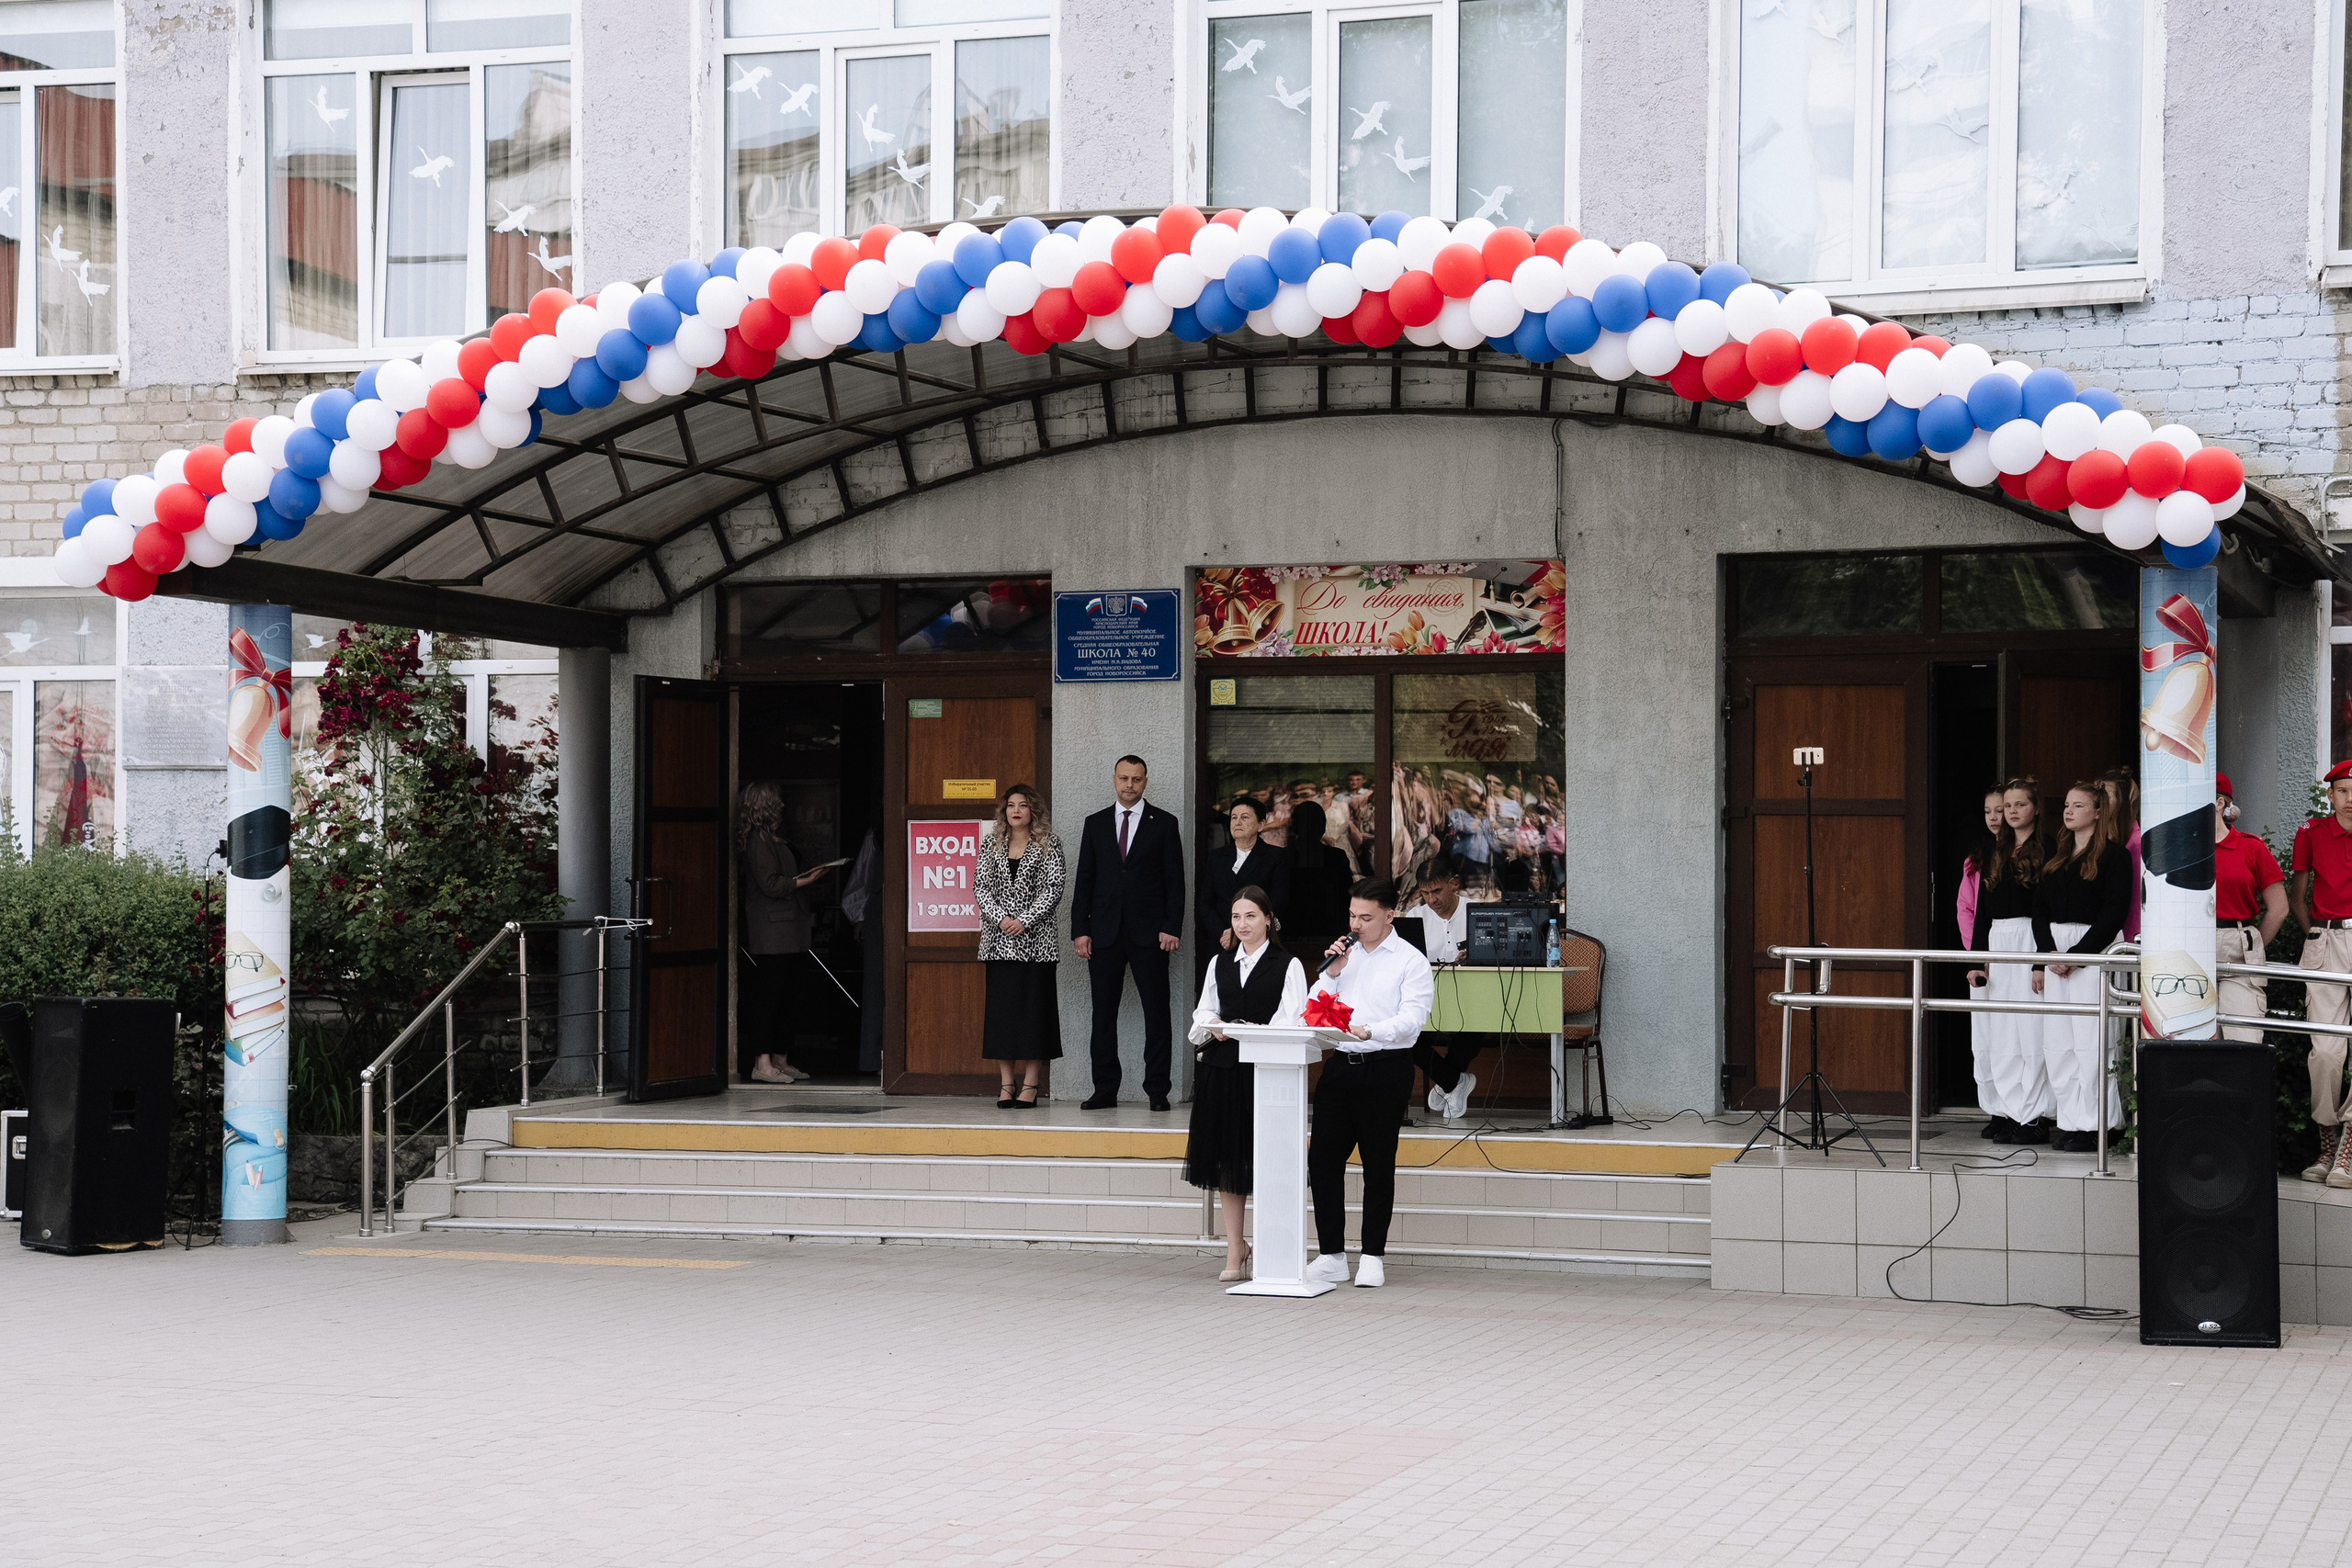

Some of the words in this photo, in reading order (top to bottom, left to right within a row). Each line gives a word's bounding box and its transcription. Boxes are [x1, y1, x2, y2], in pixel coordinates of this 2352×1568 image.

[1296, 581, 1348, 615] До
[1363, 584, 1466, 619] свидания,
[1295, 620, 1387, 644] ШКОЛА!
[1078, 649, 1121, 658] ШКОЛА
[1126, 648, 1138, 658] №
[1141, 648, 1156, 657] 40
[1444, 738, 1508, 761] мая
[916, 836, 977, 856] ВХОД
[923, 866, 967, 889] №1
[917, 902, 923, 916] 1
[927, 903, 976, 917] этаж
